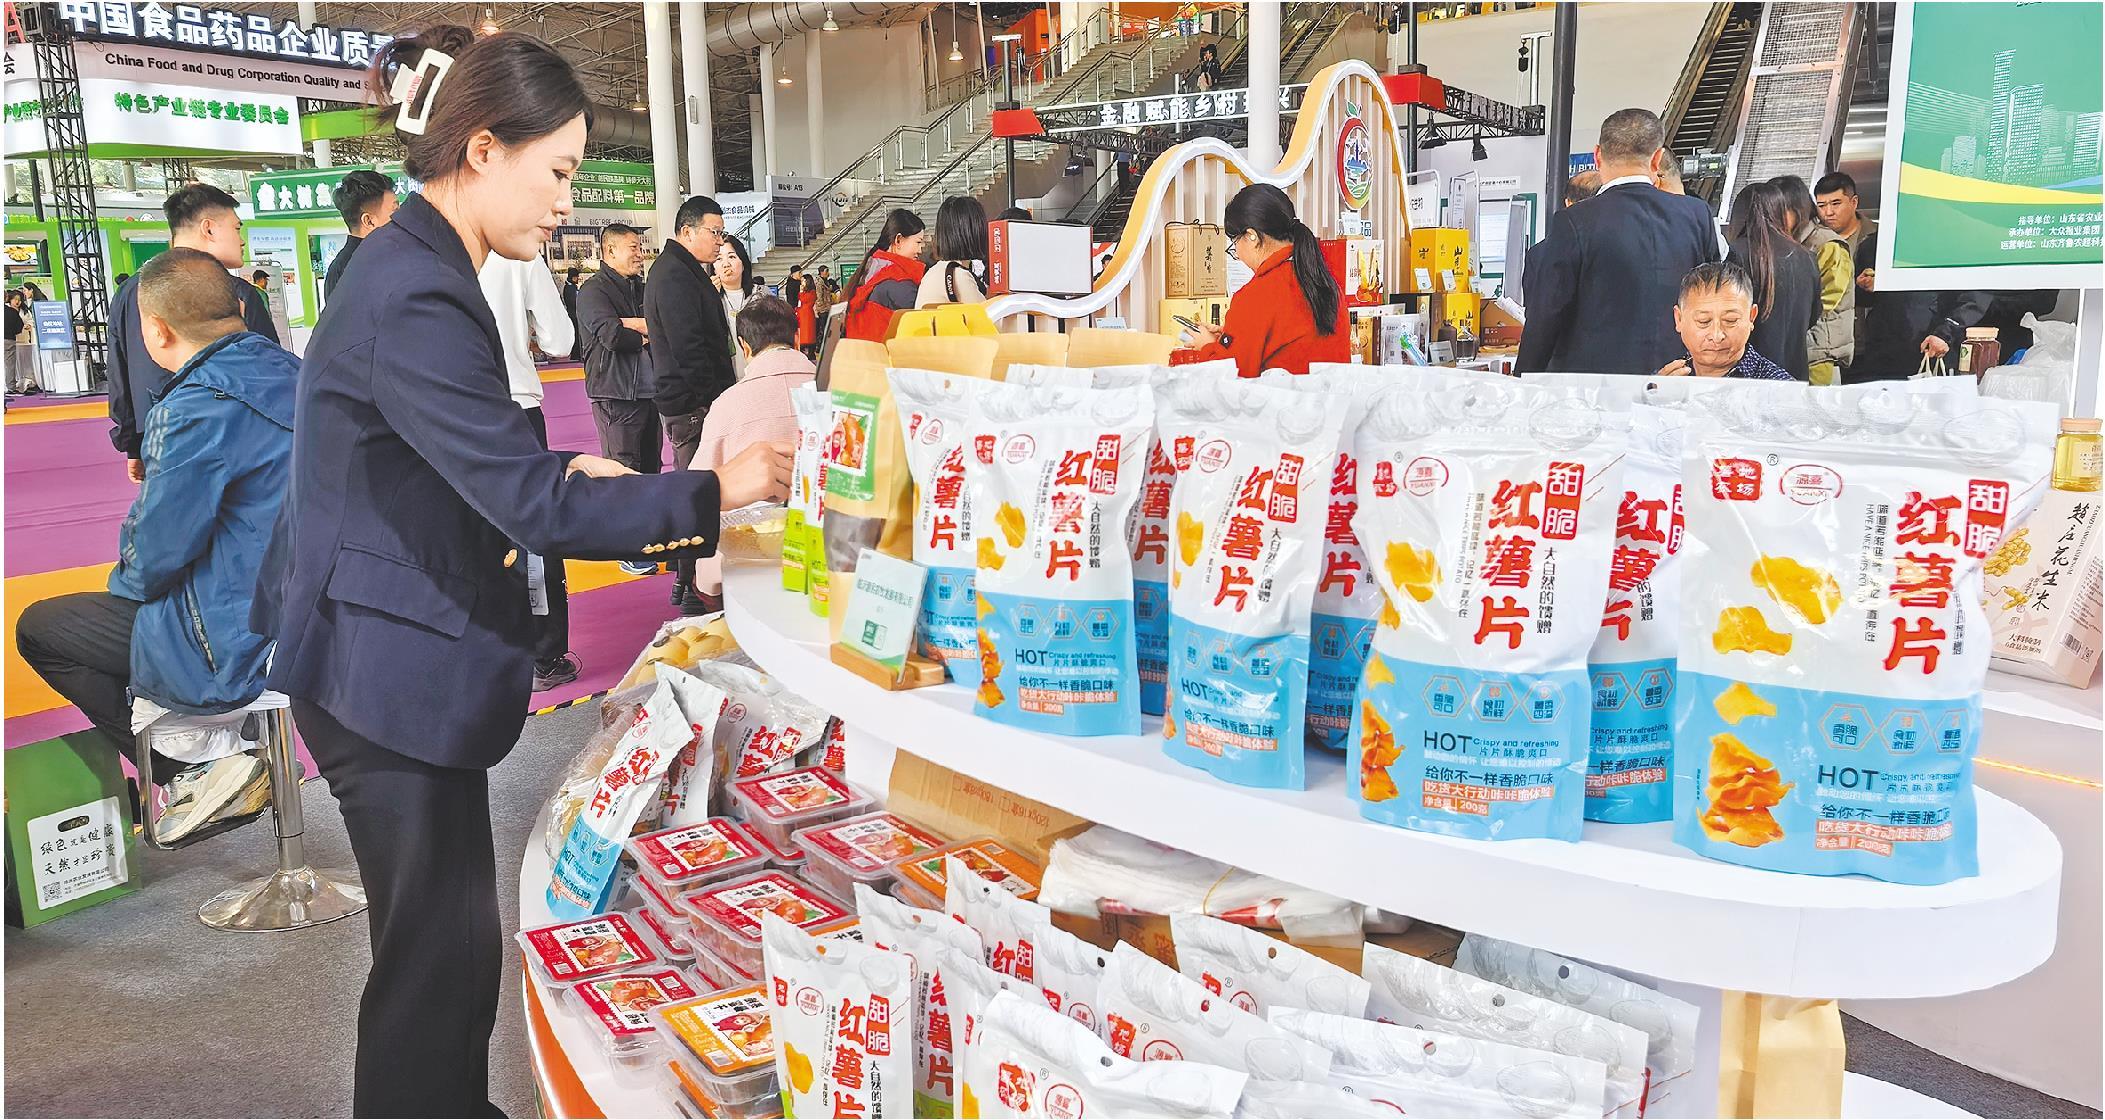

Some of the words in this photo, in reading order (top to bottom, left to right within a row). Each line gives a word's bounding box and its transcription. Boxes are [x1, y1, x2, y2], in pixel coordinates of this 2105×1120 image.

[105, 53, 144, 68] China
[149, 58, 177, 70] Food
[182, 62, 203, 74] and
[207, 64, 234, 79] Drug
[238, 68, 301, 83] Corporation
[304, 75, 339, 89] Quality
[344, 79, 361, 89] and
[1100, 87, 1290, 126] 金融赋能乡村
[1090, 439, 1119, 495] 甜脆
[1268, 457, 1303, 521] 甜脆
[1046, 450, 1092, 581] 红薯片
[1319, 452, 1361, 597] 红薯片
[1543, 466, 1582, 537] 甜脆
[1964, 482, 2008, 557] 甜脆
[1089, 501, 1101, 568] 大自然的馈赠
[1214, 466, 1274, 612] 红薯片
[1474, 480, 1543, 650] 红薯片
[1882, 491, 1962, 675] 红薯片
[1536, 547, 1558, 634] 大自然的馈赠
[1015, 648, 1048, 665] HOT
[1019, 676, 1114, 691] 给你不一样香脆口味
[1181, 678, 1208, 700] HOT
[1424, 730, 1472, 754] HOT
[1473, 738, 1500, 748] Crispy
[1502, 739, 1518, 747] and
[1520, 740, 1559, 748] refreshing
[1594, 733, 1658, 744] 片片酥脆爽口
[1617, 726, 1632, 734] and
[1634, 723, 1668, 734] refreshing
[1479, 747, 1547, 758] 片片酥脆爽口
[591, 749, 660, 818] 红薯片
[1424, 781, 1552, 801] 吃货大行动咔咔脆体验
[1425, 765, 1553, 788] 给你不一样香脆口味
[1817, 765, 1879, 791] HOT
[1880, 772, 1907, 782] Crispy
[1461, 800, 1488, 814] 200克
[1816, 836, 1850, 849] 净含量
[1857, 838, 1891, 854] 200克
[866, 996, 890, 1054] 甜脆
[832, 998, 865, 1119] 红薯片
